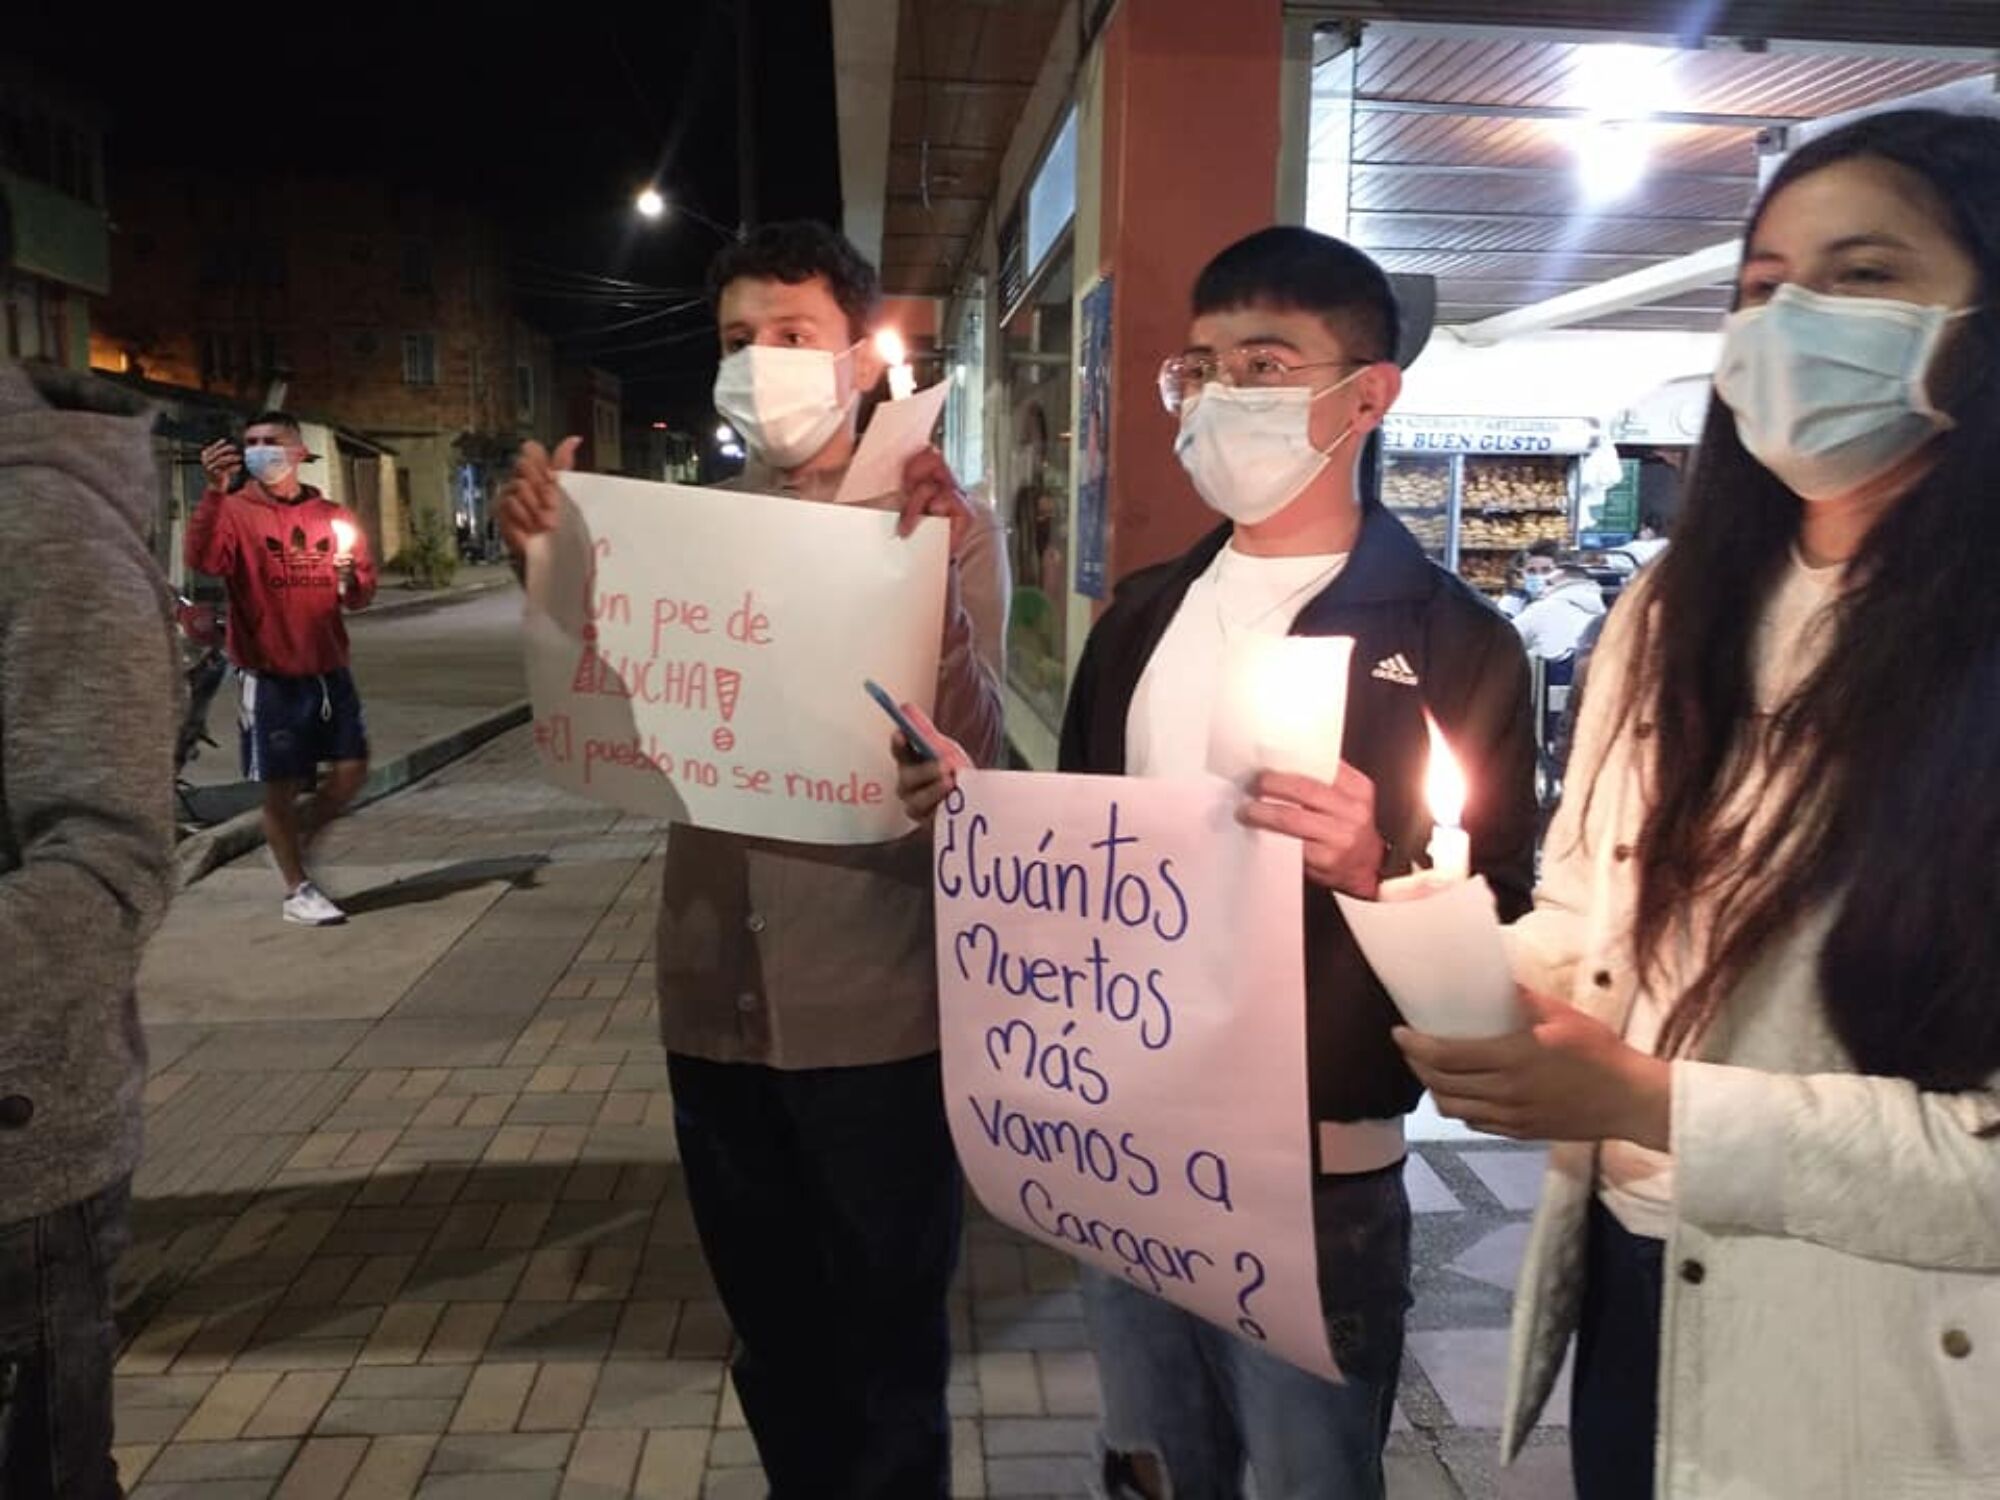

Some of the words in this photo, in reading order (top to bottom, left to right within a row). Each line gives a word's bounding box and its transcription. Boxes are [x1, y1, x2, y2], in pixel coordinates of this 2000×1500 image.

[1413, 433, 1472, 449] BUEN
[1479, 435, 1552, 451] GUSTO
[652, 597, 711, 658] pie
[726, 592, 774, 646] de
[683, 758, 719, 787] no
[731, 765, 773, 795] se
[785, 771, 884, 806] rinde
[1186, 1150, 1235, 1213] a
